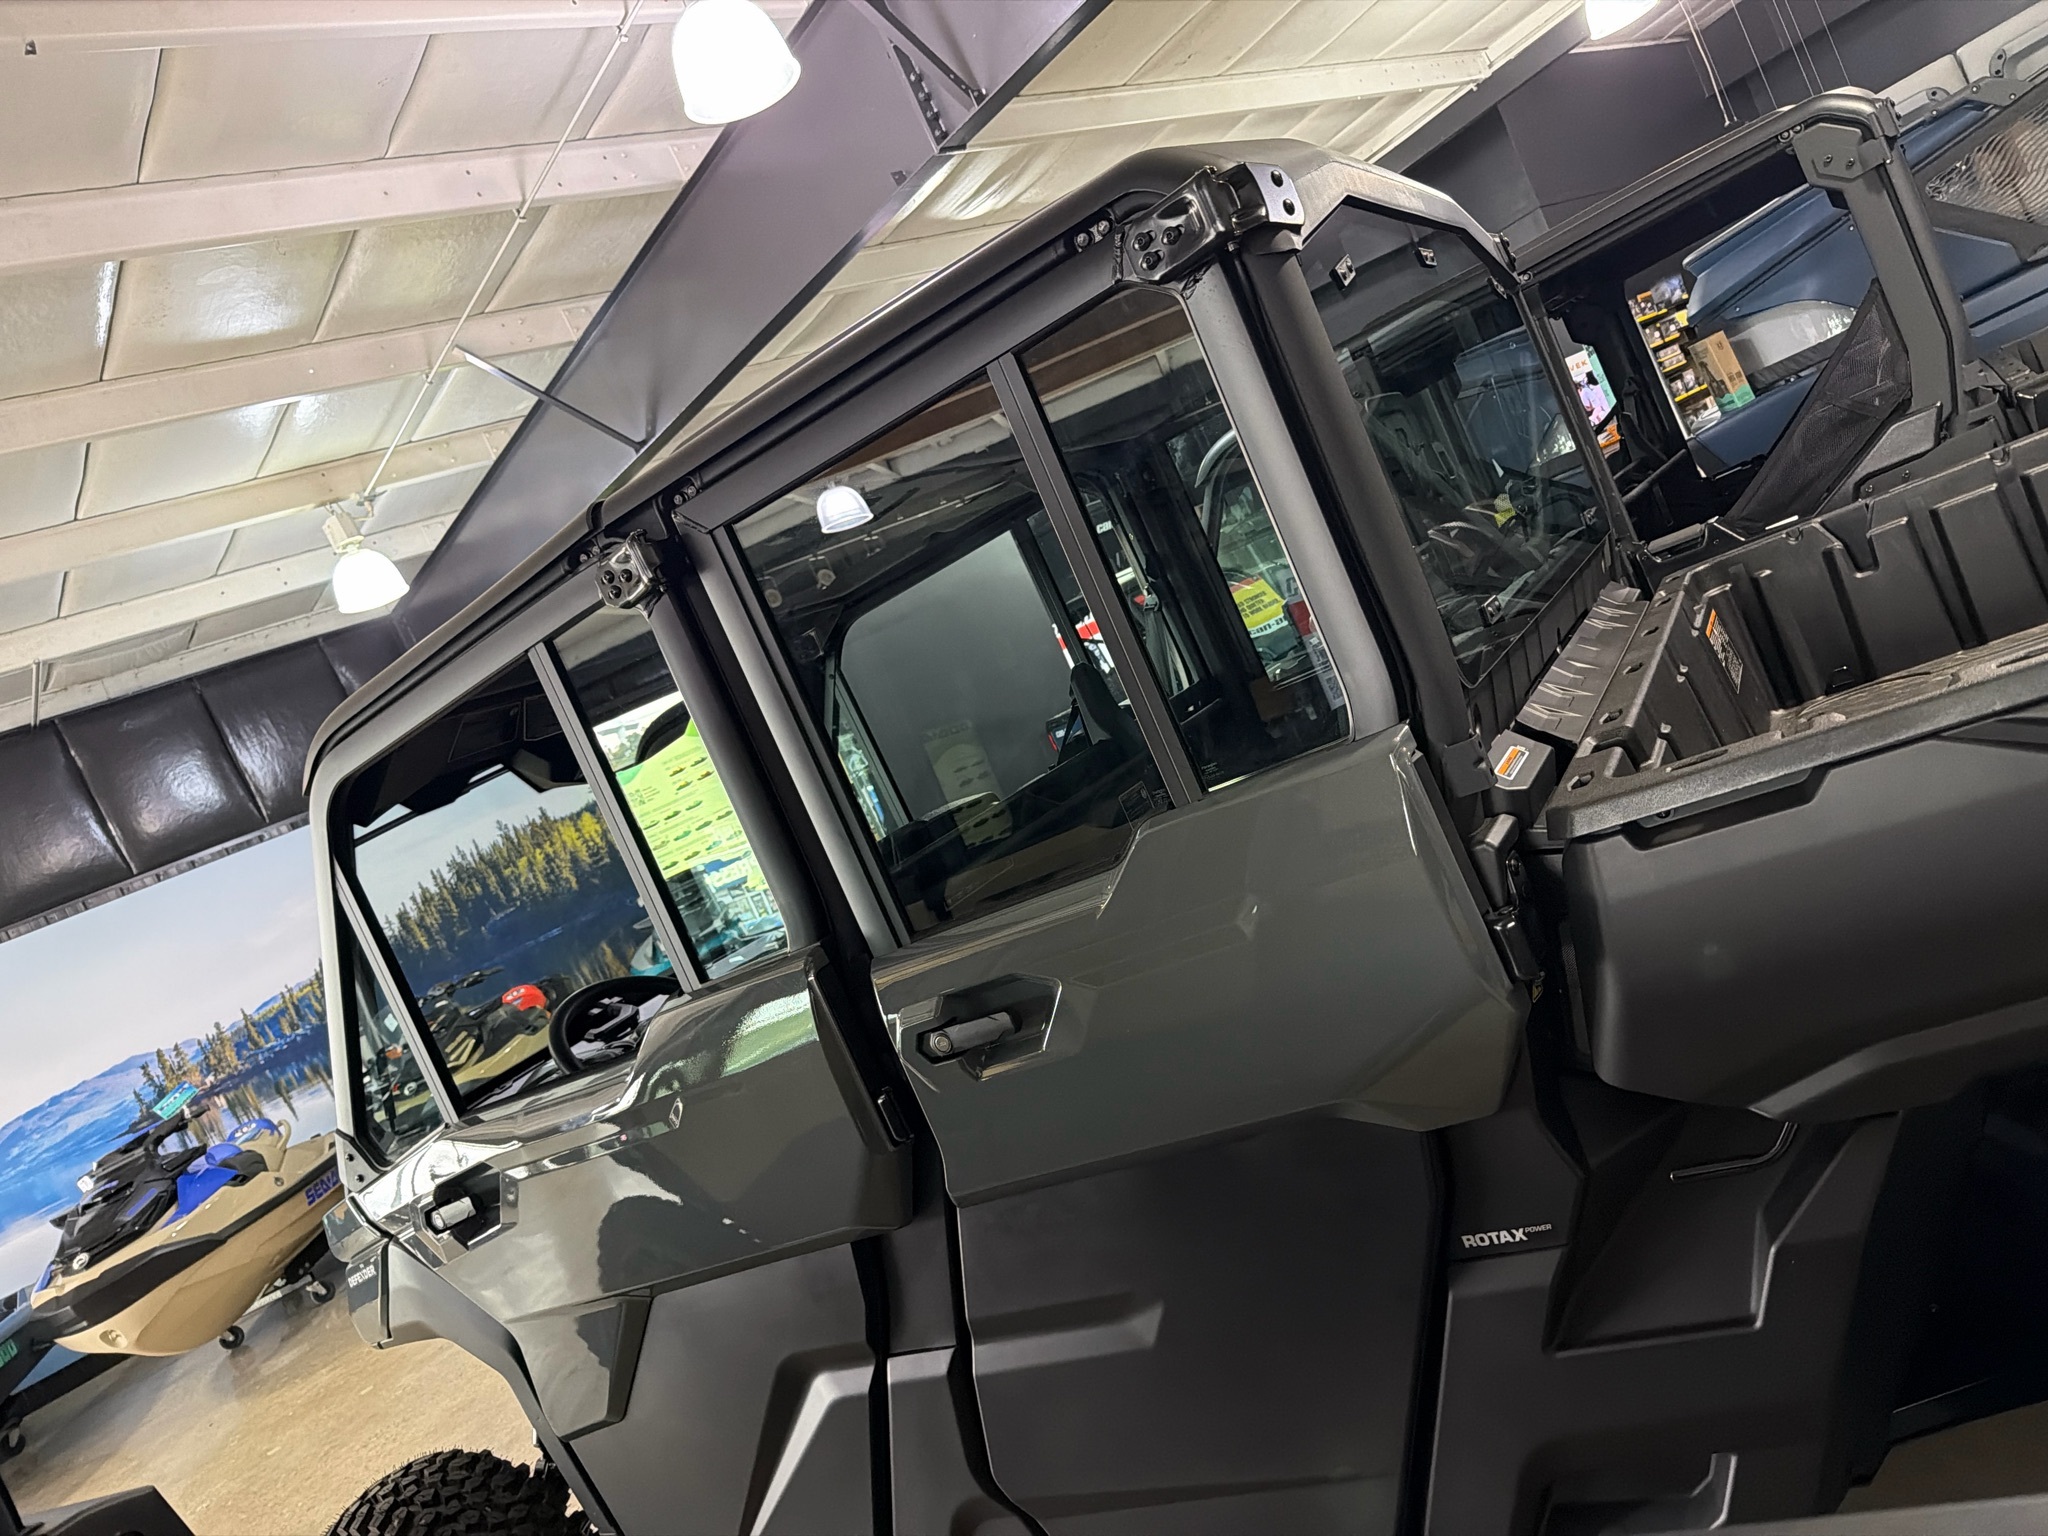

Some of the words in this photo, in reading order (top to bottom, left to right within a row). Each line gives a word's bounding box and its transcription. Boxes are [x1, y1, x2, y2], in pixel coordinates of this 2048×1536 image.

[1461, 1228, 1528, 1248] ROTAX
[1524, 1223, 1552, 1233] POWER
[347, 1265, 377, 1288] DEFENDER
